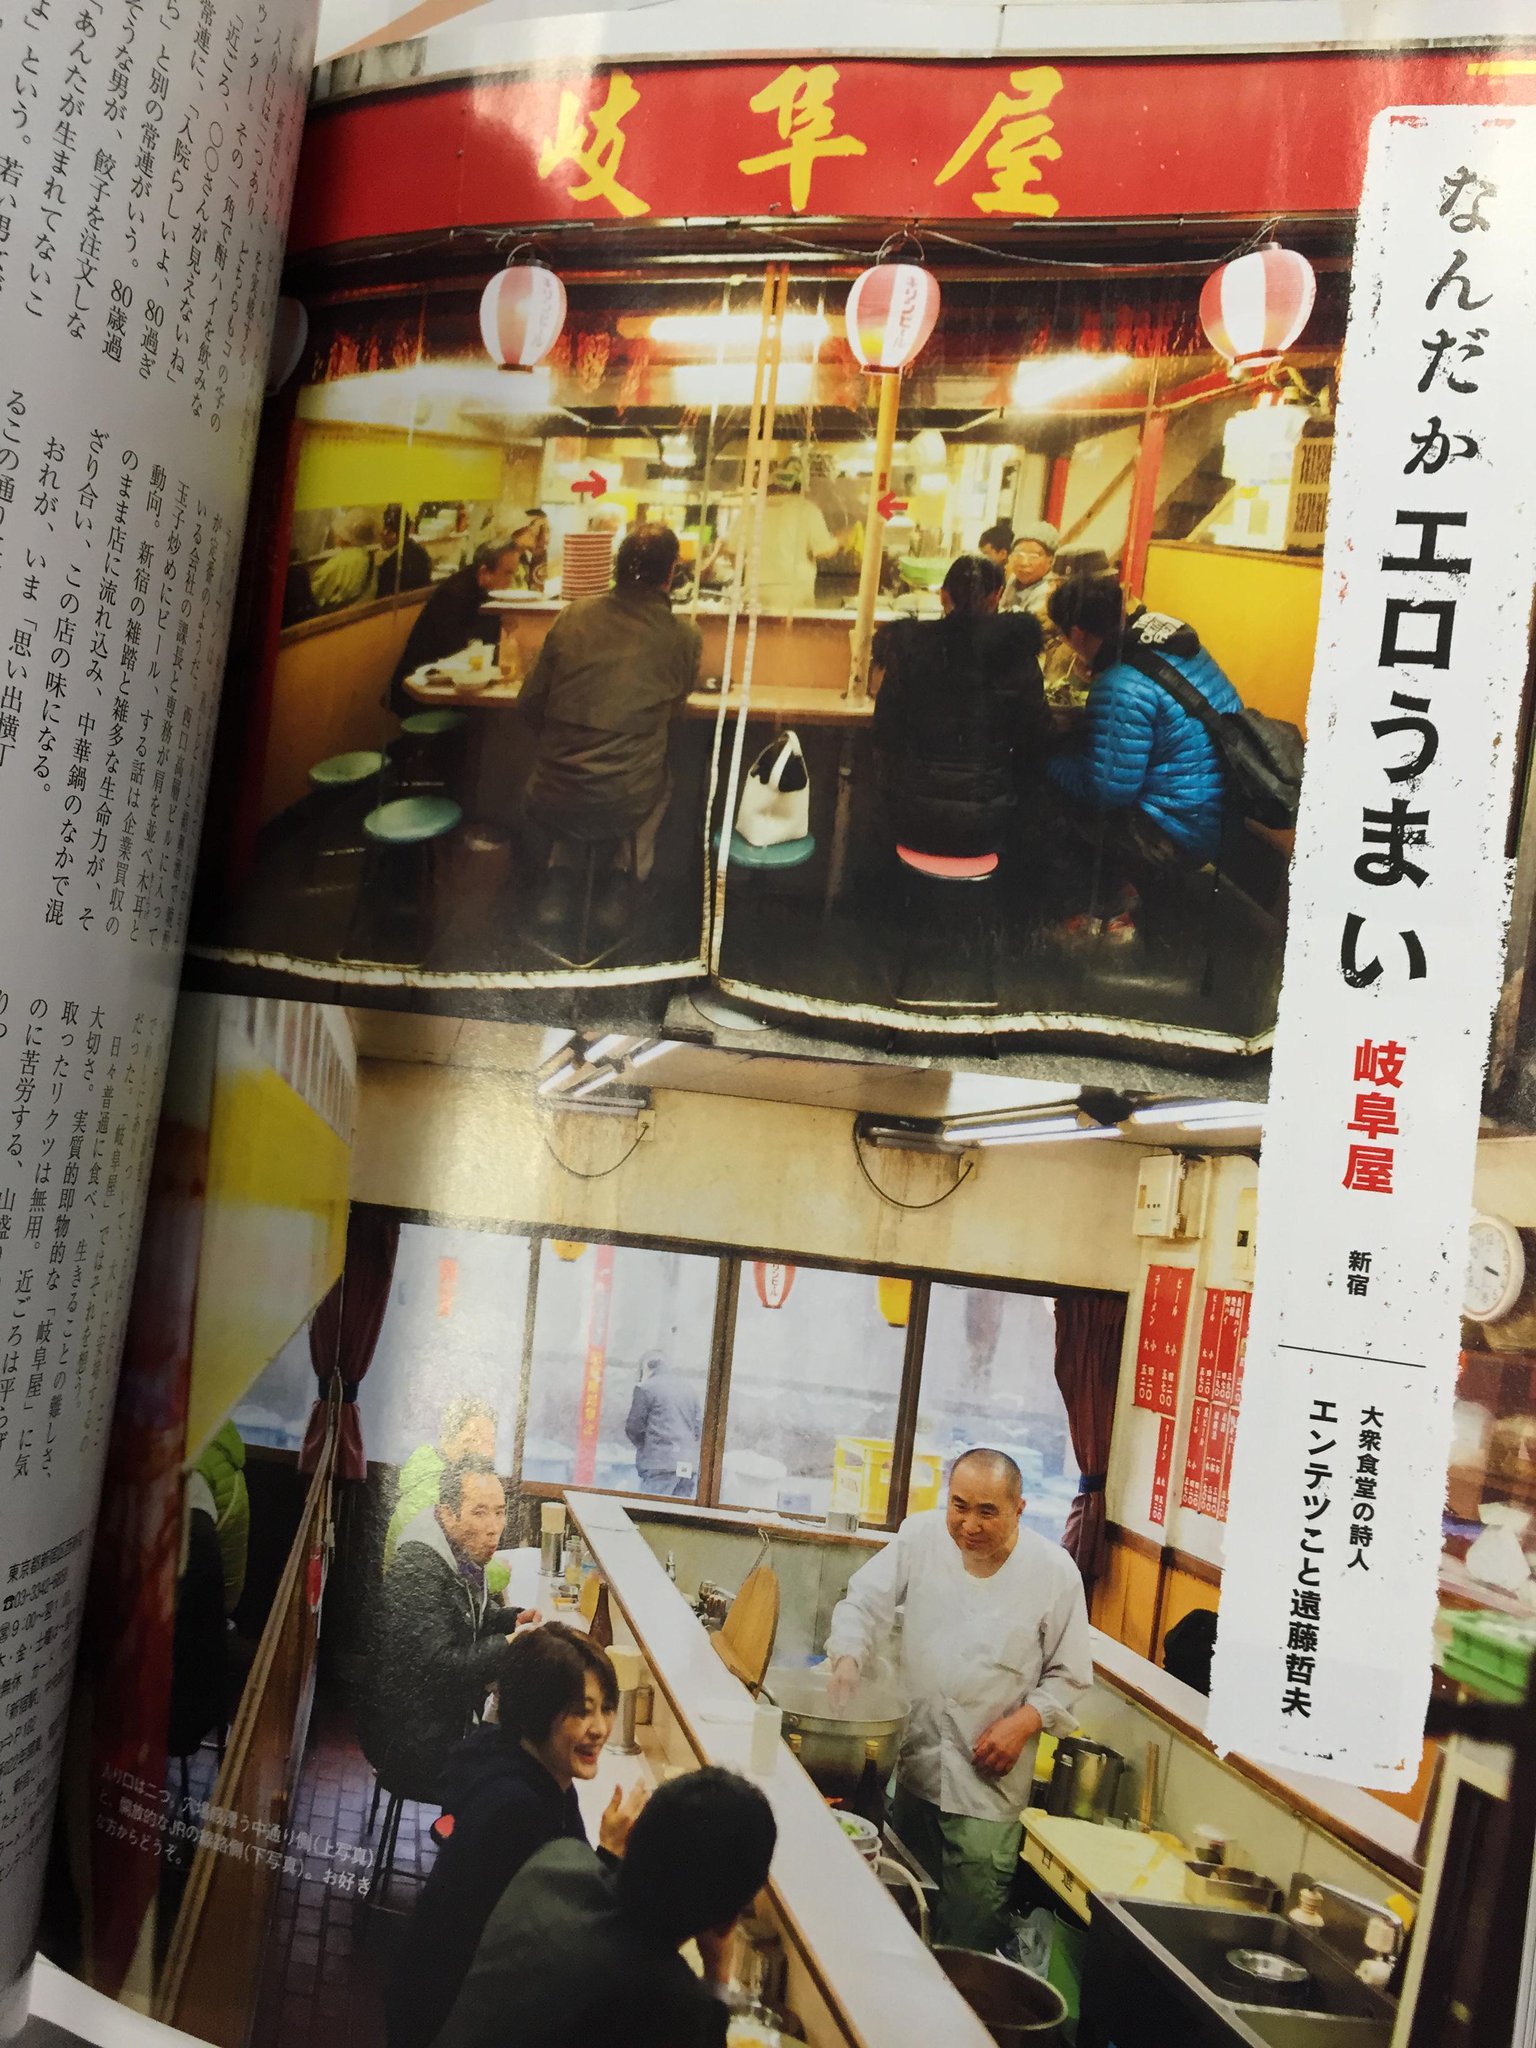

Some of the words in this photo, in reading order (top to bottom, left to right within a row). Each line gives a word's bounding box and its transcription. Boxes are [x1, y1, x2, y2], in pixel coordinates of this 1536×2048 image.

[1342, 1038, 1407, 1195] 岐阜屋
[1346, 1249, 1372, 1297] 新宿
[1281, 1399, 1339, 1719] エンテツこと遠藤哲夫
[1347, 1405, 1384, 1571] 大衆食堂の詩人
